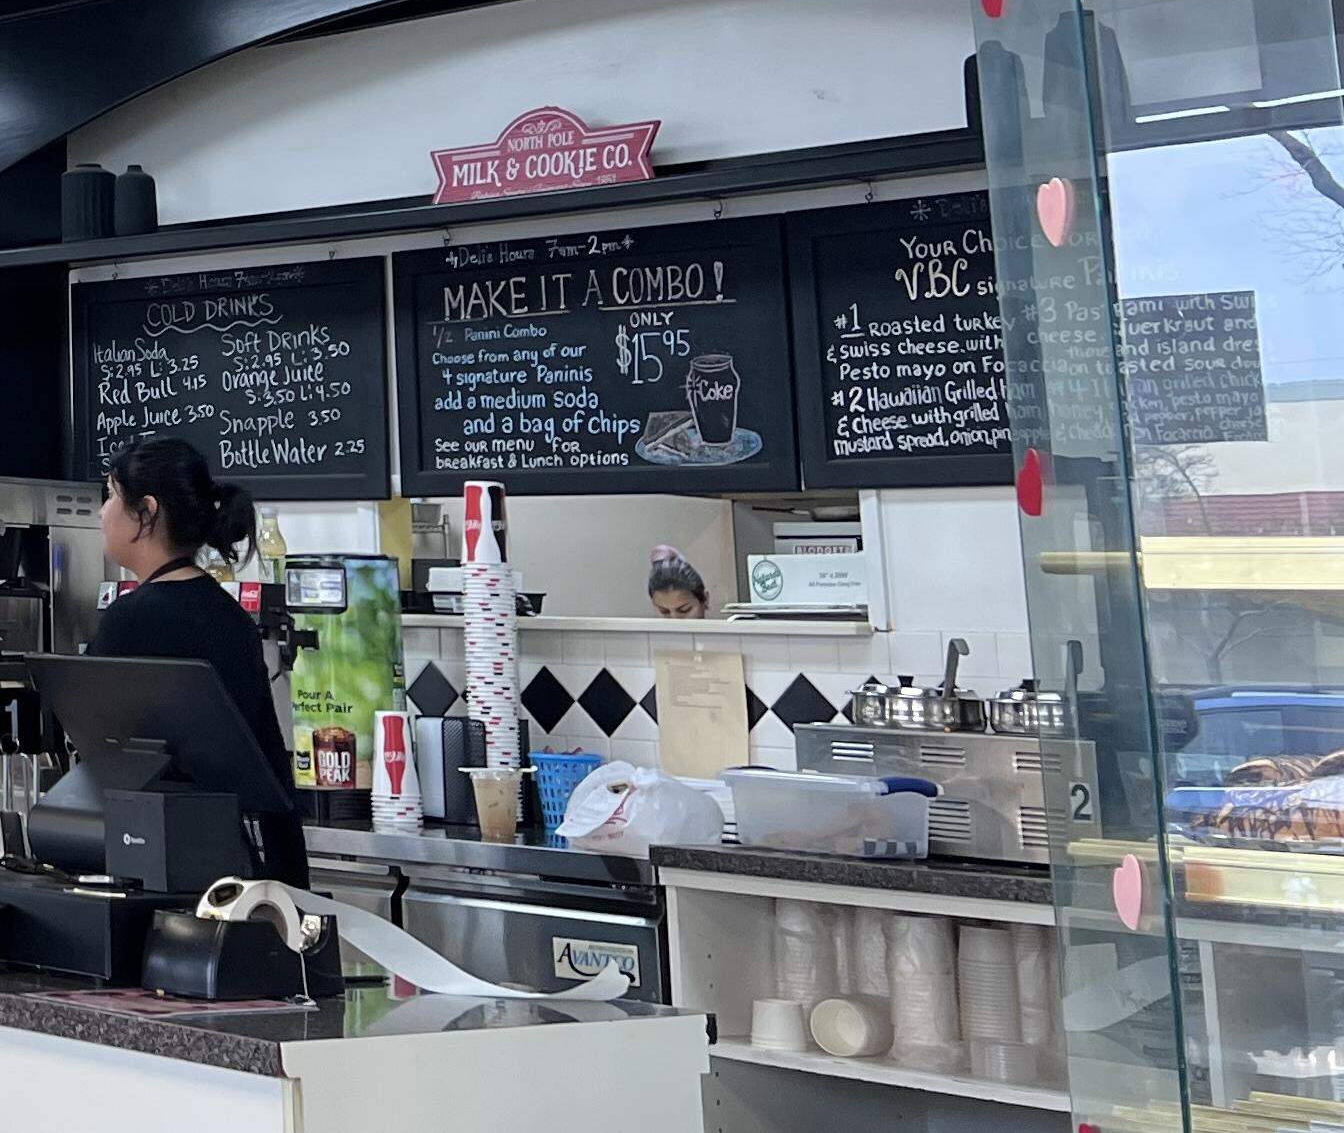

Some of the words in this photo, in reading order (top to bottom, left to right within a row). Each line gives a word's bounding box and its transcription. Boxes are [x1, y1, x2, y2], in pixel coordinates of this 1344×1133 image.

[507, 134, 543, 153] NORTH
[547, 130, 575, 147] POLE
[452, 159, 502, 187] MILK
[506, 158, 520, 180] &
[525, 147, 597, 179] COOKIE
[602, 143, 633, 169] CO.
[894, 258, 970, 301] VBC
[443, 277, 529, 321] MAKE
[540, 272, 572, 312] IT
[582, 269, 604, 307] A
[146, 300, 195, 328] COLD
[205, 293, 275, 319] DRINKS
[629, 311, 674, 328] ONLY
[221, 331, 262, 357] Soft
[464, 326, 501, 343] Panini
[503, 323, 548, 340] Combo
[965, 335, 1003, 353] with
[1156, 337, 1216, 354] island
[93, 340, 135, 365] Italian
[135, 337, 169, 363] Soda
[432, 351, 475, 365] Choose
[477, 349, 510, 363] from
[513, 348, 539, 367] any
[542, 342, 558, 359] of
[560, 344, 587, 358] our
[222, 368, 279, 393] Orange
[283, 362, 324, 387] Juice
[442, 369, 453, 385] 4
[456, 368, 528, 392] signature
[536, 364, 594, 384] Paninis
[839, 361, 891, 382] Pesto
[895, 362, 946, 382] mayo
[952, 360, 976, 375] on
[98, 381, 131, 406] Red
[135, 376, 178, 403] Bull
[434, 392, 463, 411] add
[466, 395, 477, 409] a
[480, 389, 546, 410] medium
[553, 385, 600, 410] soda
[699, 380, 734, 402] Coke
[867, 384, 941, 413] Hawaiian
[944, 376, 997, 405] Grilled
[96, 408, 137, 434] Apple
[140, 405, 182, 429] Juice
[185, 404, 215, 423] 3.50
[219, 408, 296, 436] Snapple
[308, 408, 341, 427] 3.50
[463, 412, 496, 436] and
[501, 418, 513, 434] a
[520, 412, 555, 444] bag
[561, 410, 586, 434] of
[911, 405, 951, 426] with
[953, 401, 999, 429] grilled
[219, 439, 270, 469] Bottle
[270, 437, 328, 466] Water
[434, 438, 461, 454] See
[491, 438, 535, 454] menu
[833, 432, 894, 456] mustard
[435, 455, 504, 471] breakfast
[508, 452, 517, 468] &
[570, 452, 629, 468] options
[297, 689, 322, 700] Pour
[325, 689, 335, 700] A
[4, 698, 19, 742] 1
[326, 703, 354, 714] Pair
[318, 751, 351, 768] GOLD
[319, 766, 351, 783] PEAK
[1071, 784, 1092, 821] 2
